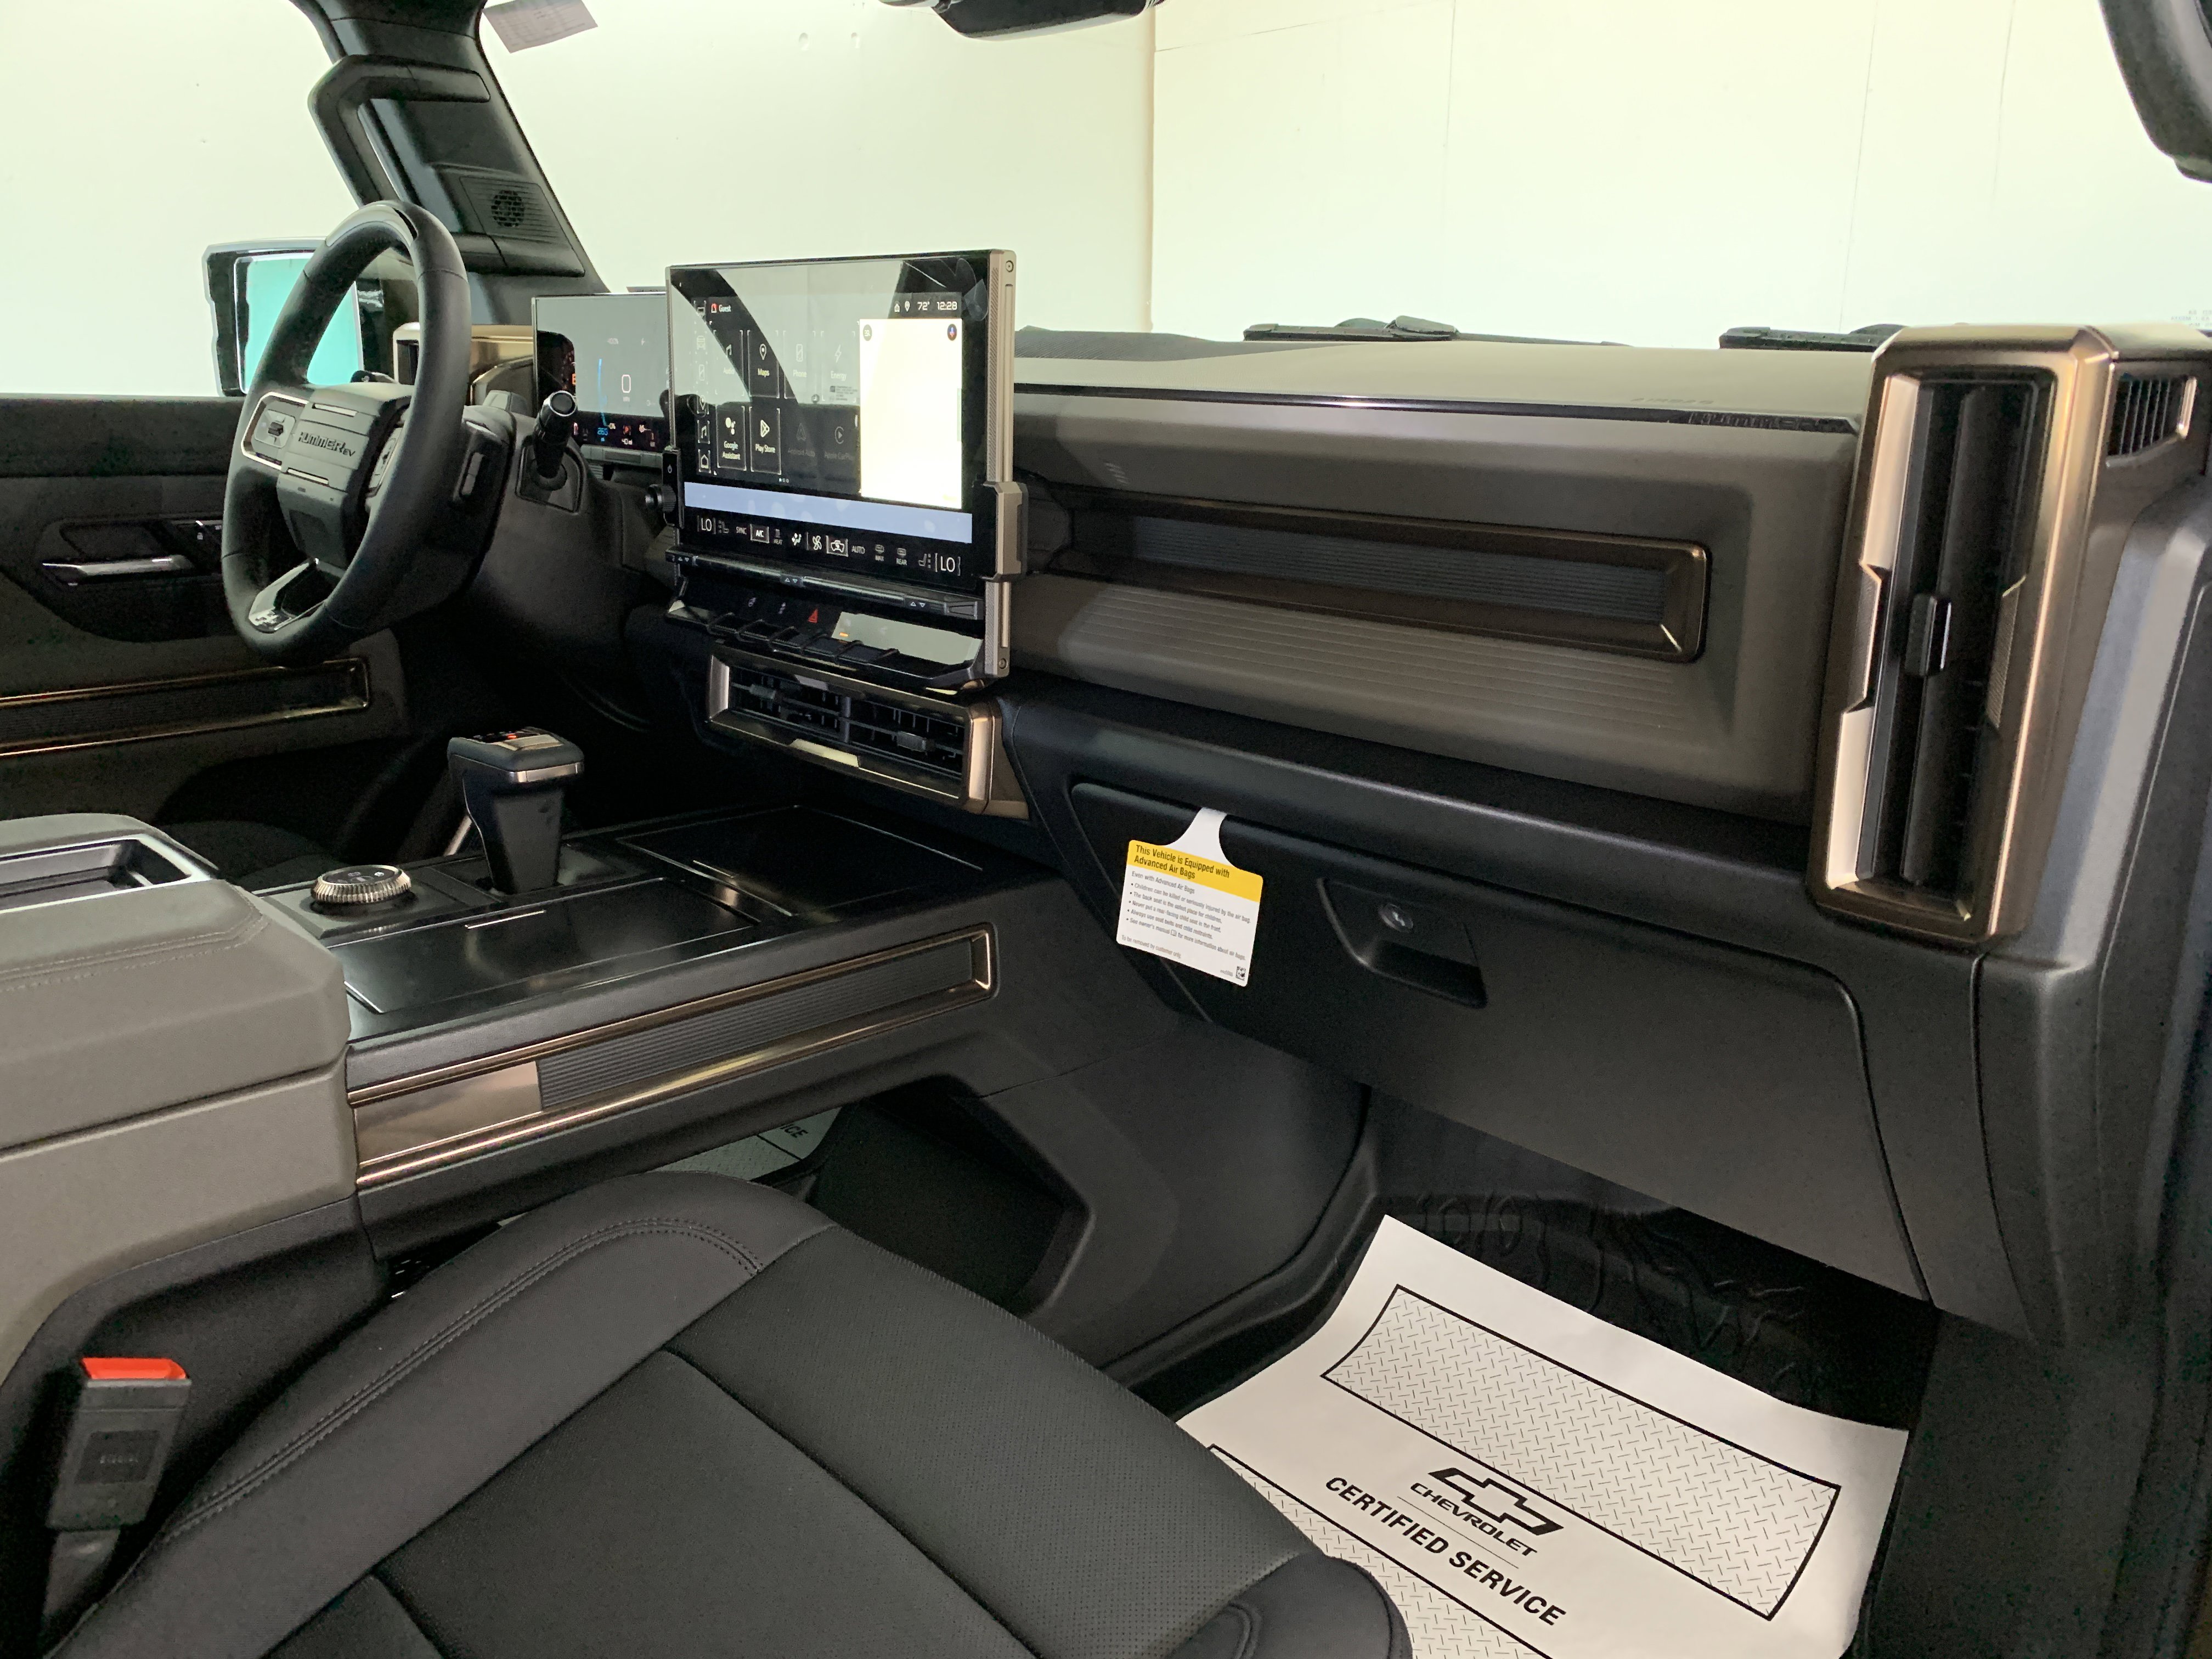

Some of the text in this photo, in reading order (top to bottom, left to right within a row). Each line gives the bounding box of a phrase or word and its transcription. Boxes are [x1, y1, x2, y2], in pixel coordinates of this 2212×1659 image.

[937, 301, 958, 311] 12:28
[758, 368, 770, 377] Maps
[793, 369, 807, 378] Phone
[831, 370, 847, 381] Energy
[298, 432, 346, 453] HUMMER
[724, 441, 738, 450] Google
[755, 443, 776, 454] Play Store
[722, 452, 741, 460] Assistant
[701, 517, 712, 532] LO
[736, 527, 747, 535] SYNC
[851, 546, 865, 555] AUTO
[941, 556, 955, 572] LO
[1136, 844, 1230, 878] This Vehicle is Equipped with
[1134, 855, 1195, 879] Advanced Air Bags
[1410, 1482, 1538, 1556] CHEVROLET
[1325, 1476, 1567, 1626] CERTIFIED SERVICE
